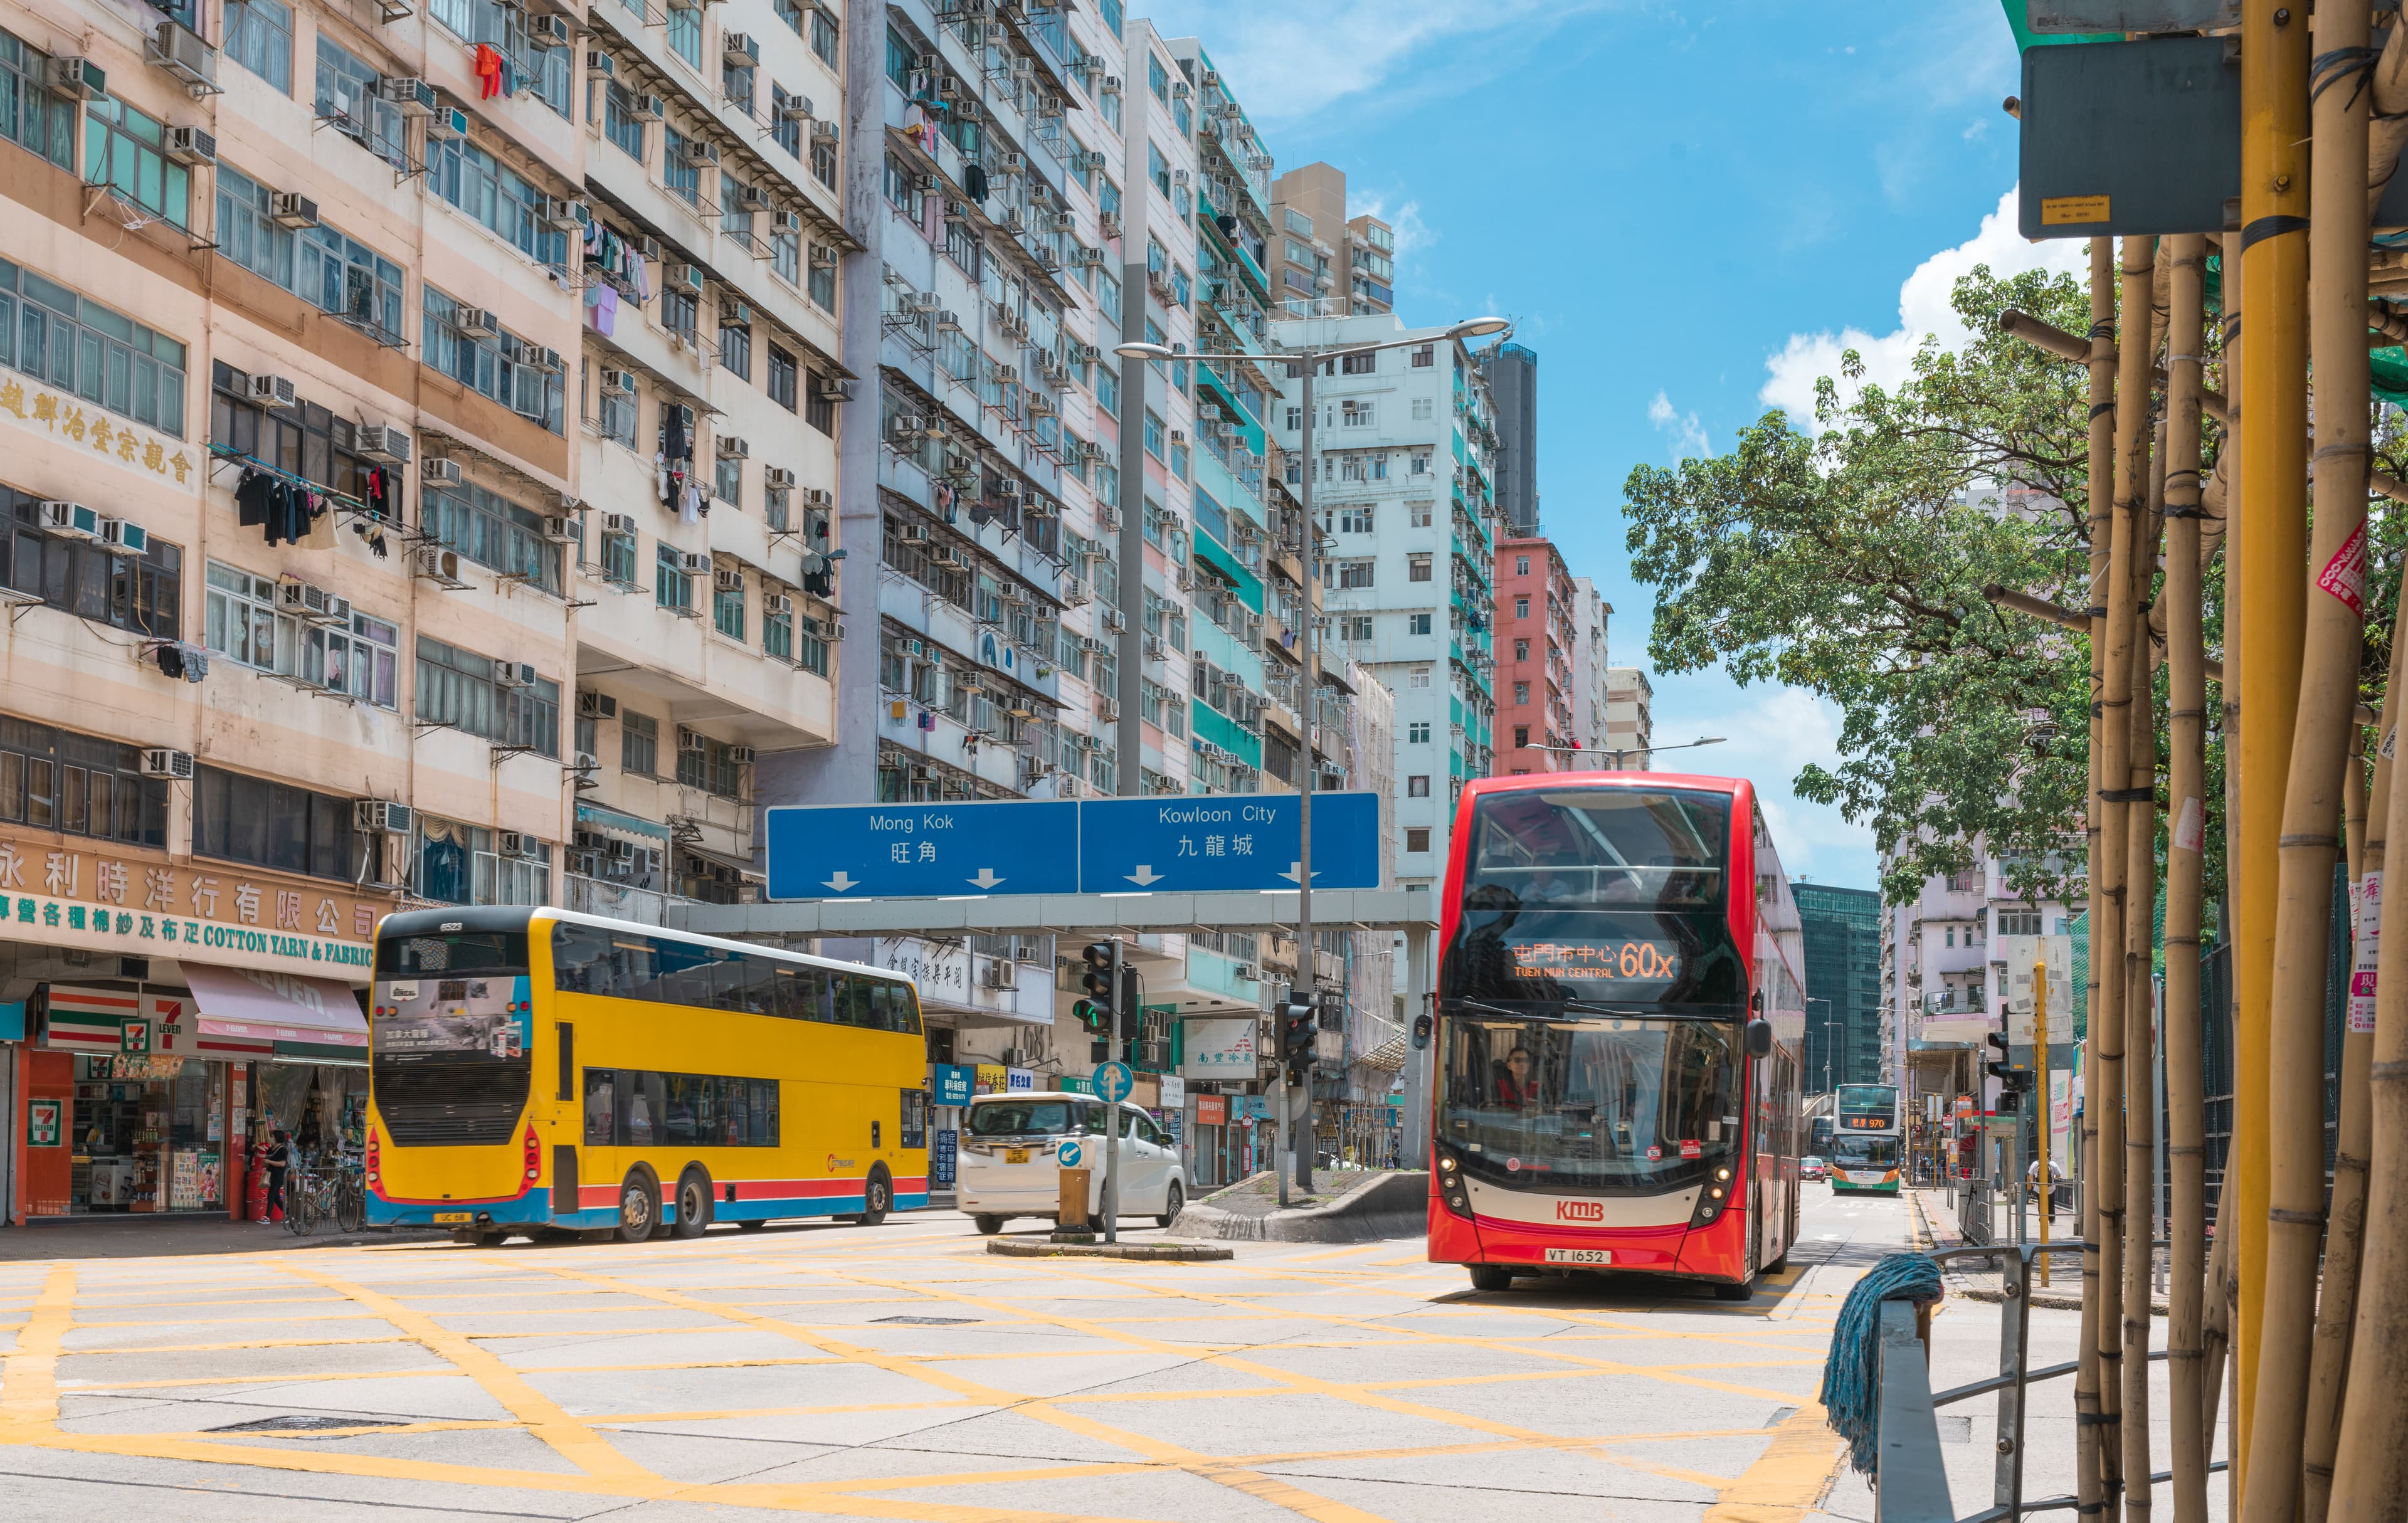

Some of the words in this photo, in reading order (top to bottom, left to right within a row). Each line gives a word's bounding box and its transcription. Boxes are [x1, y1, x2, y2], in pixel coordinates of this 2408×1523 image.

[870, 815, 913, 833] Mong
[924, 814, 954, 830] Kok
[1159, 806, 1231, 823] Kowloon
[1242, 805, 1276, 825] City
[891, 840, 936, 863] 旺角
[1177, 833, 1253, 857] 九龍城
[0, 842, 376, 942] 永利時洋行有限公司
[440, 923, 463, 932] 6523
[204, 925, 268, 953] COTTON
[270, 935, 309, 959] YARN
[312, 941, 321, 961] &
[325, 943, 374, 967] FABRIC
[1513, 944, 1617, 963] 屯門市中心
[1514, 967, 1541, 977] TUEN
[1544, 967, 1565, 978] MUN
[1568, 967, 1615, 979] CENTRAL
[156, 1000, 181, 1049] 7
[128, 1026, 144, 1050] 7
[1198, 1052, 1253, 1063] 南豐冷氣
[36, 1109, 54, 1141] 7
[1869, 1119, 1884, 1128] 970
[1549, 1250, 1566, 1261] VT
[1571, 1252, 1603, 1262] 1652
